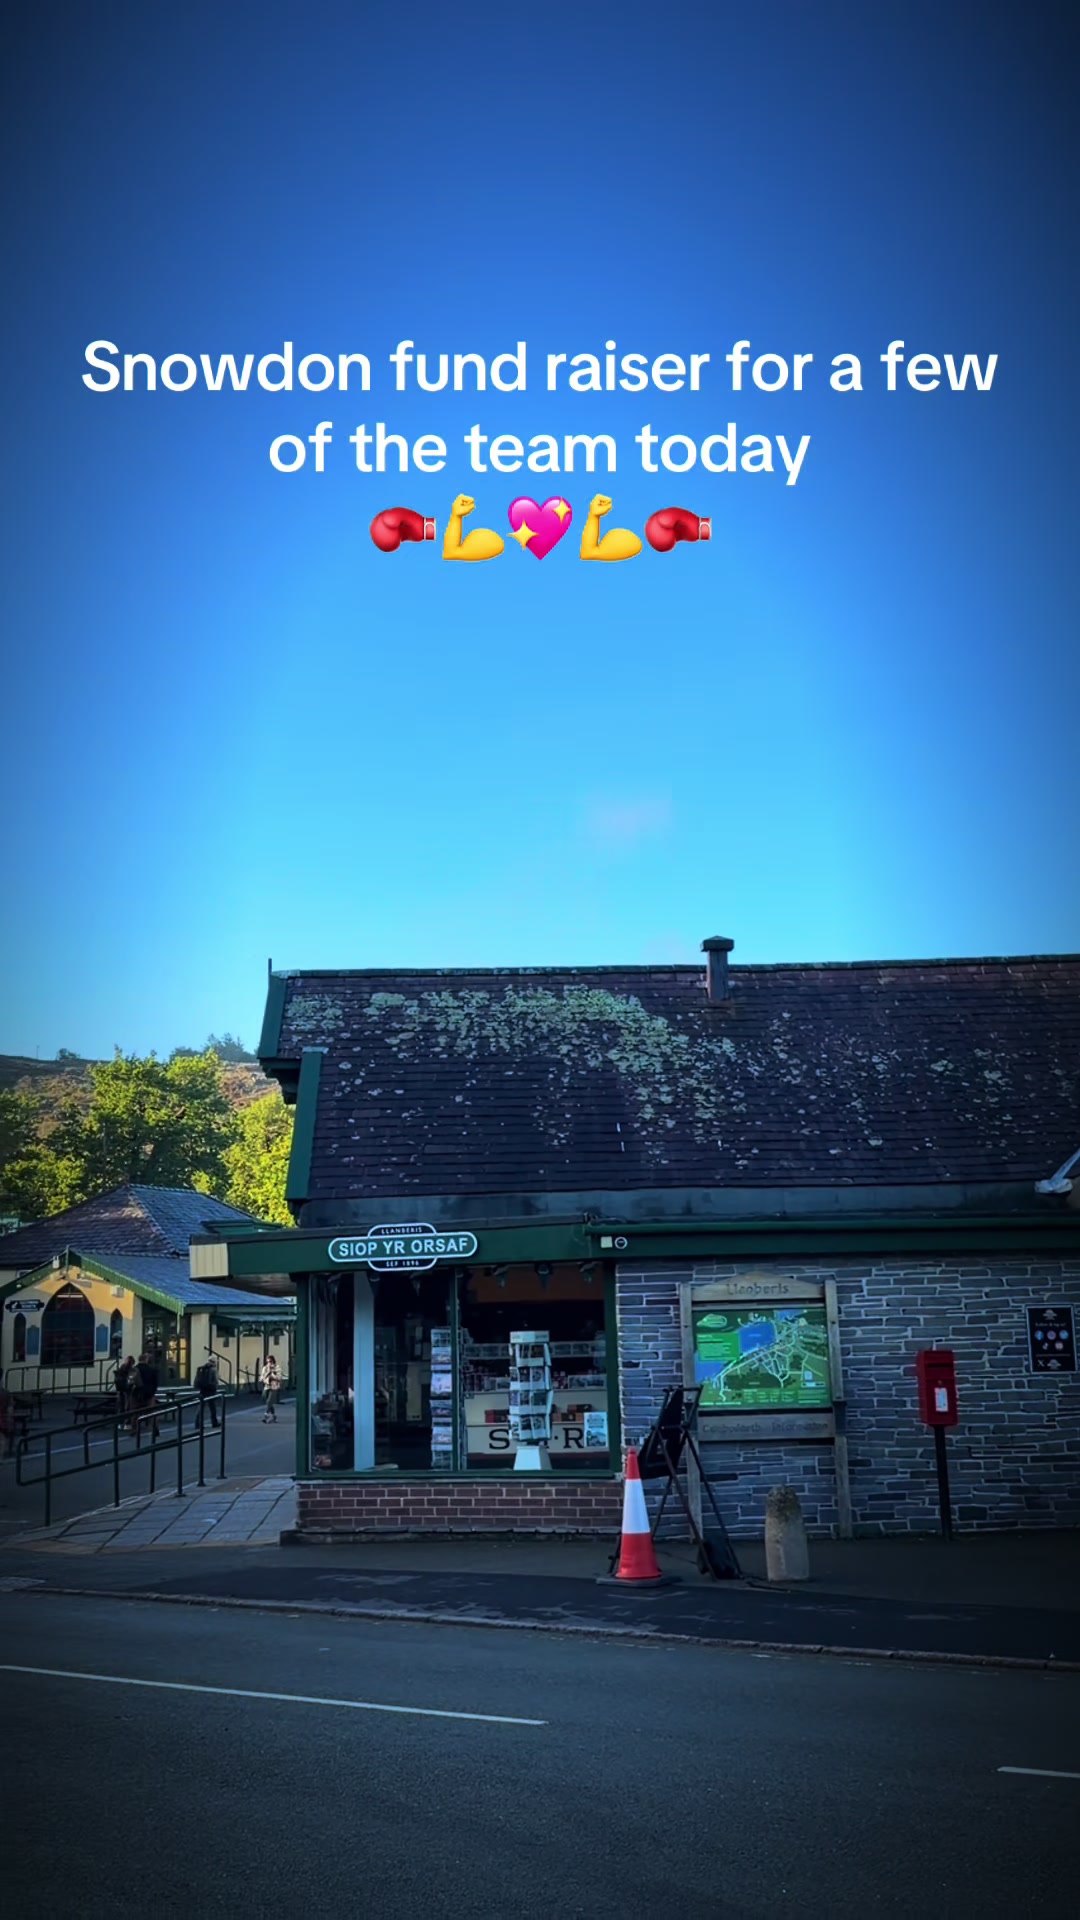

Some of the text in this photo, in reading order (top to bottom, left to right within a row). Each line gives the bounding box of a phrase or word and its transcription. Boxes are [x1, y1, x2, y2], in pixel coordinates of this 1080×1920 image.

[381, 1226, 422, 1235] LLANBERIS
[339, 1237, 469, 1257] SIOP YR ORSAF
